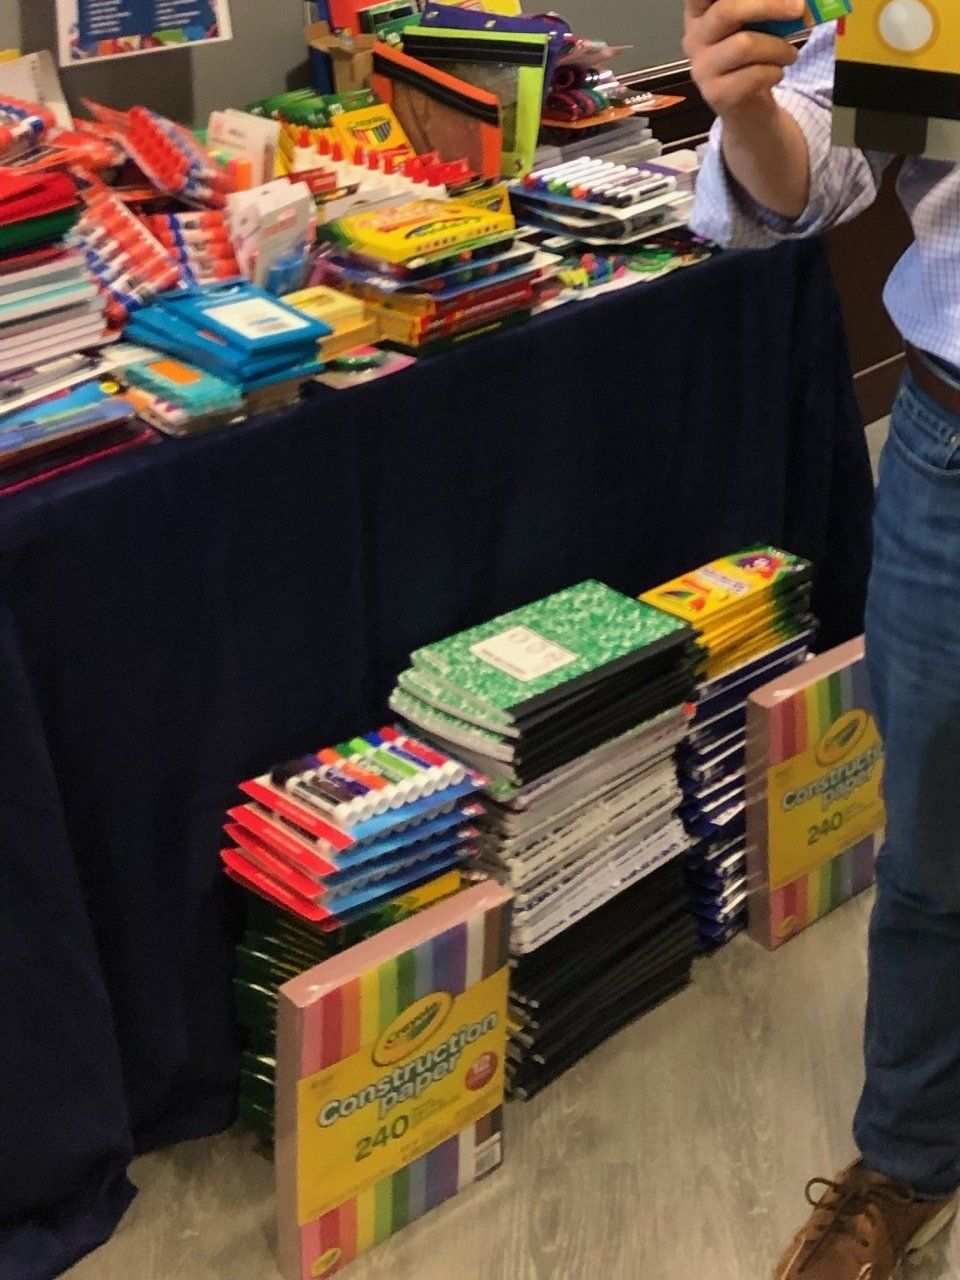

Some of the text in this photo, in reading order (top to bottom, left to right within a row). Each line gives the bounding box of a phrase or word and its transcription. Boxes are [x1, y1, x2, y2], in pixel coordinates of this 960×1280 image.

[807, 811, 843, 846] 240
[316, 1011, 498, 1129] Construction
[377, 1054, 463, 1120] paper
[355, 1114, 410, 1163] 240
